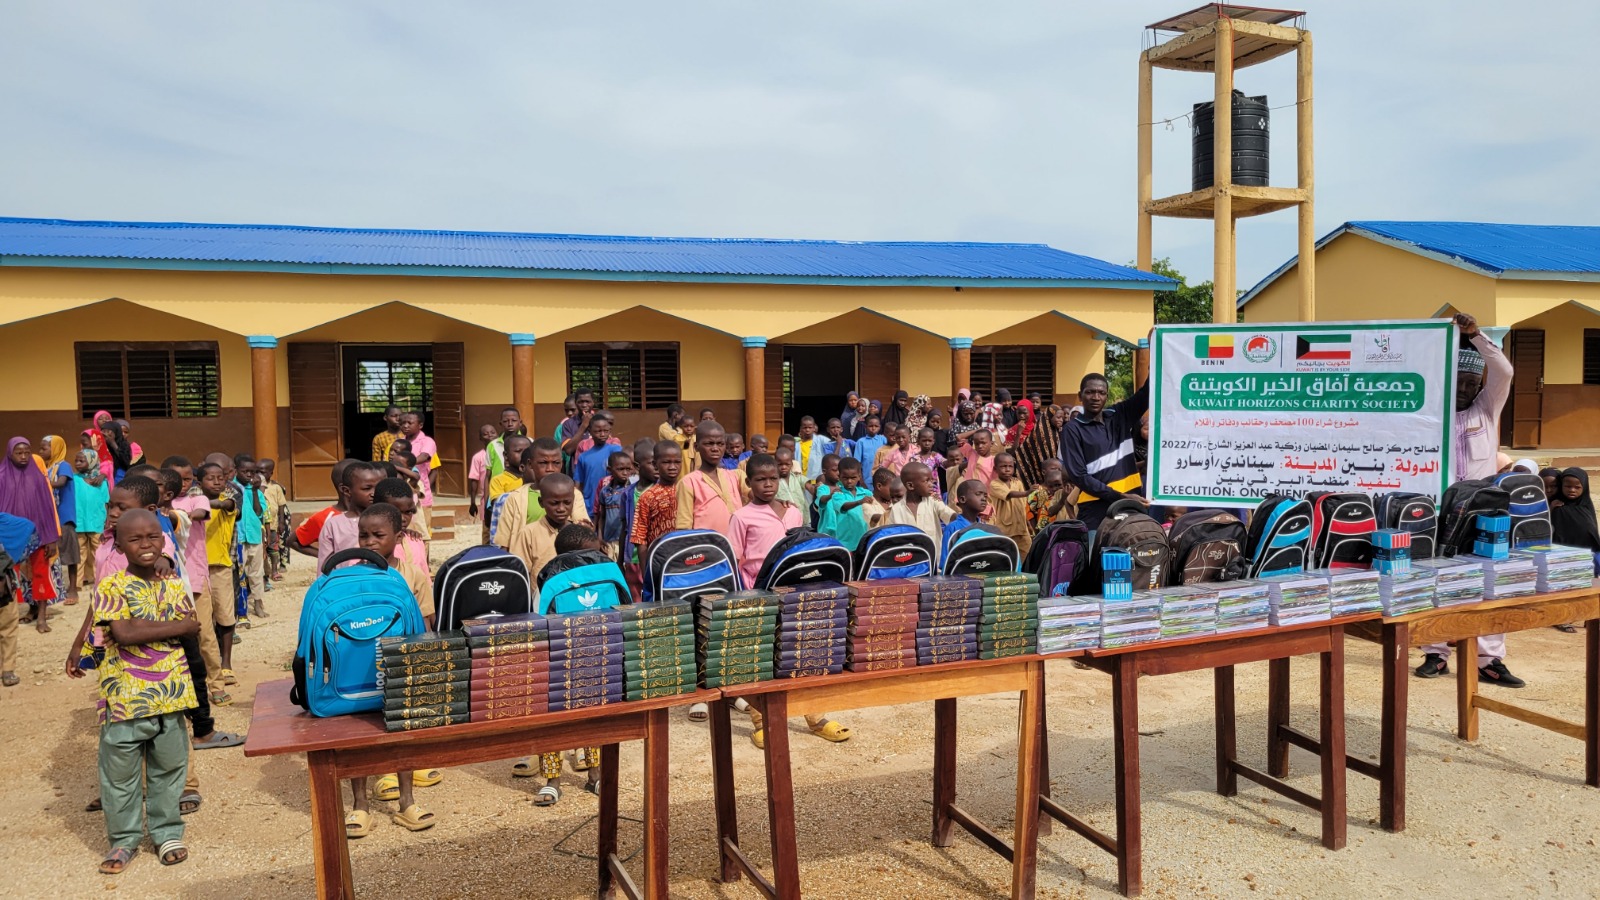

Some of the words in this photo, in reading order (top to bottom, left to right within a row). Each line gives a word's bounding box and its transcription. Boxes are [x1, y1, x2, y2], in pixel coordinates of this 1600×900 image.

[1188, 377, 1256, 396] الكويتية
[1260, 377, 1301, 397] الخير
[1306, 374, 1350, 397] آفاق
[1354, 377, 1415, 396] جمعية
[1188, 398, 1235, 408] KUWAIT
[1237, 398, 1300, 409] HORIZONS
[1302, 399, 1360, 409] CHARITY
[1362, 399, 1419, 409] SOCIETY
[1216, 418, 1240, 428] ودفاتر
[1315, 418, 1333, 428] شراء
[1334, 417, 1359, 429] مشروع
[1233, 441, 1257, 451] العزيز
[1258, 442, 1273, 451] عبد
[1274, 442, 1302, 452] وزكية
[1331, 444, 1361, 453] سليمان
[1362, 444, 1384, 454] صالح
[1385, 444, 1412, 454] مركز
[1413, 445, 1440, 455] لصالح
[1341, 458, 1385, 476] بنين
[1216, 473, 1245, 486] بنين
[1247, 474, 1268, 488] في
[1275, 475, 1304, 488] البر
[1306, 475, 1350, 486] منظمة
[1162, 485, 1235, 497] EXECUTION:
